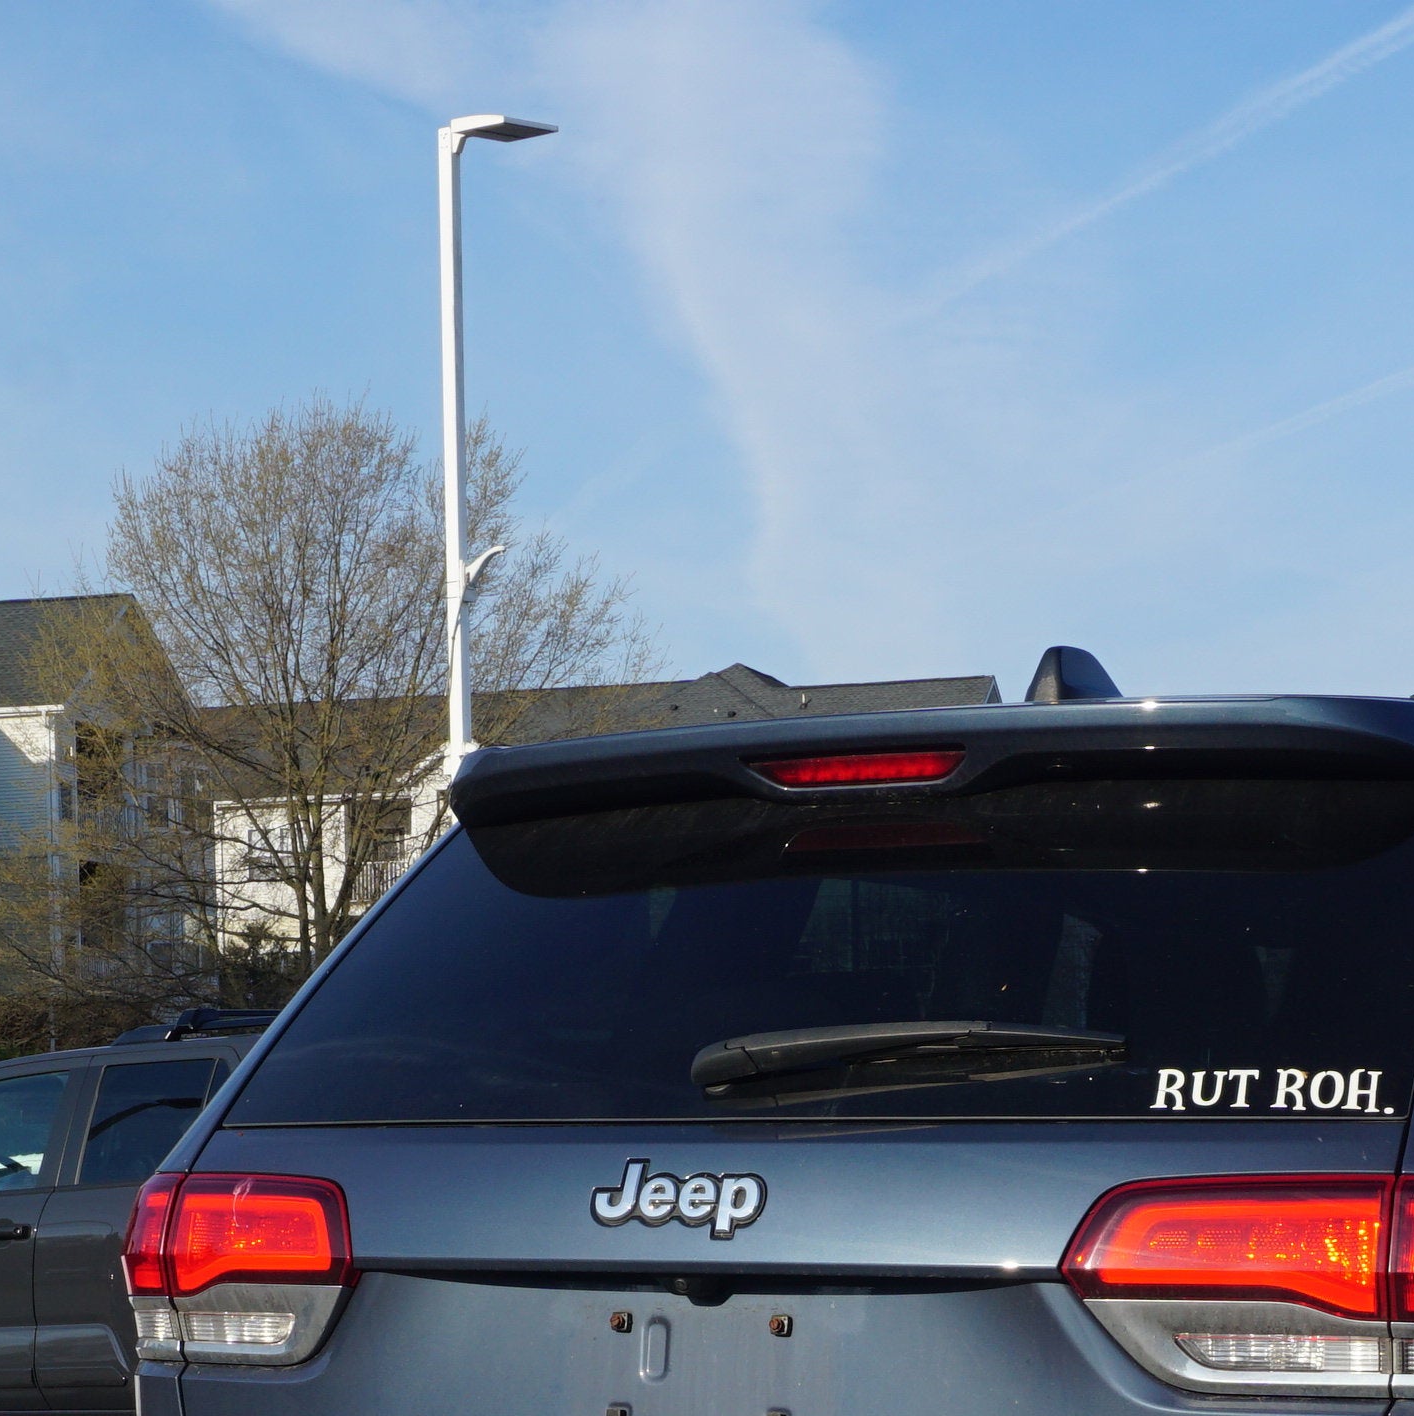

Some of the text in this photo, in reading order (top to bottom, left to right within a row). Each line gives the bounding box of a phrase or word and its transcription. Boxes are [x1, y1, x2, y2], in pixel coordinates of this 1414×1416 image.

[1149, 1068, 1394, 1115] RUT ROH.
[591, 1158, 767, 1240] Jeep
